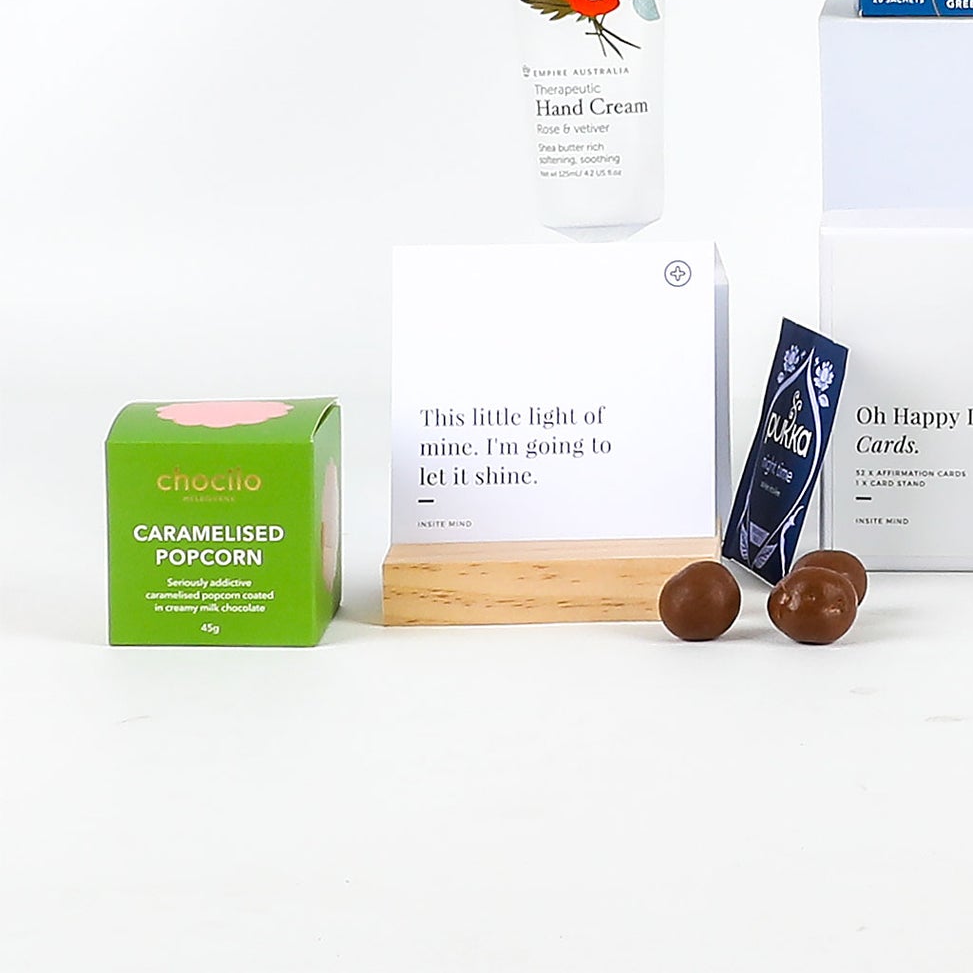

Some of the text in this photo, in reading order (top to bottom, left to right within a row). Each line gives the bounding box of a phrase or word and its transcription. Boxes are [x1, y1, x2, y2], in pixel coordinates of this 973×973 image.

[533, 67, 630, 78] EMPIRE AUSTRALIA
[534, 82, 602, 97] Therapeutic
[536, 97, 648, 117] Hand Cream
[536, 123, 610, 135] Rose & vetiver
[538, 142, 605, 153] Shea butter rich
[579, 154, 621, 165] soothing
[420, 406, 606, 429] This little light of
[764, 390, 812, 458] pukka
[856, 405, 886, 425] Oh
[893, 407, 960, 430] Happy
[420, 436, 612, 459] mine. I'm going to
[856, 434, 919, 454] Cards.
[156, 465, 262, 492] chocilo
[418, 465, 538, 487] let it shine.
[855, 469, 865, 477] 52
[876, 469, 935, 477] AFFIRMATION
[936, 470, 966, 478] CARDS
[869, 479, 895, 487] CARD
[896, 480, 926, 488] STAND
[417, 520, 473, 528] INSITE MIND
[855, 517, 910, 525] INSITE MIND
[133, 524, 284, 542] CARAMELISED
[156, 548, 262, 566] POPCORN
[166, 577, 253, 590] Seriously addictive
[145, 590, 275, 602] caramelised popcorn coated
[154, 602, 266, 615] in creamy milk chocolate
[200, 623, 220, 635] 45g
